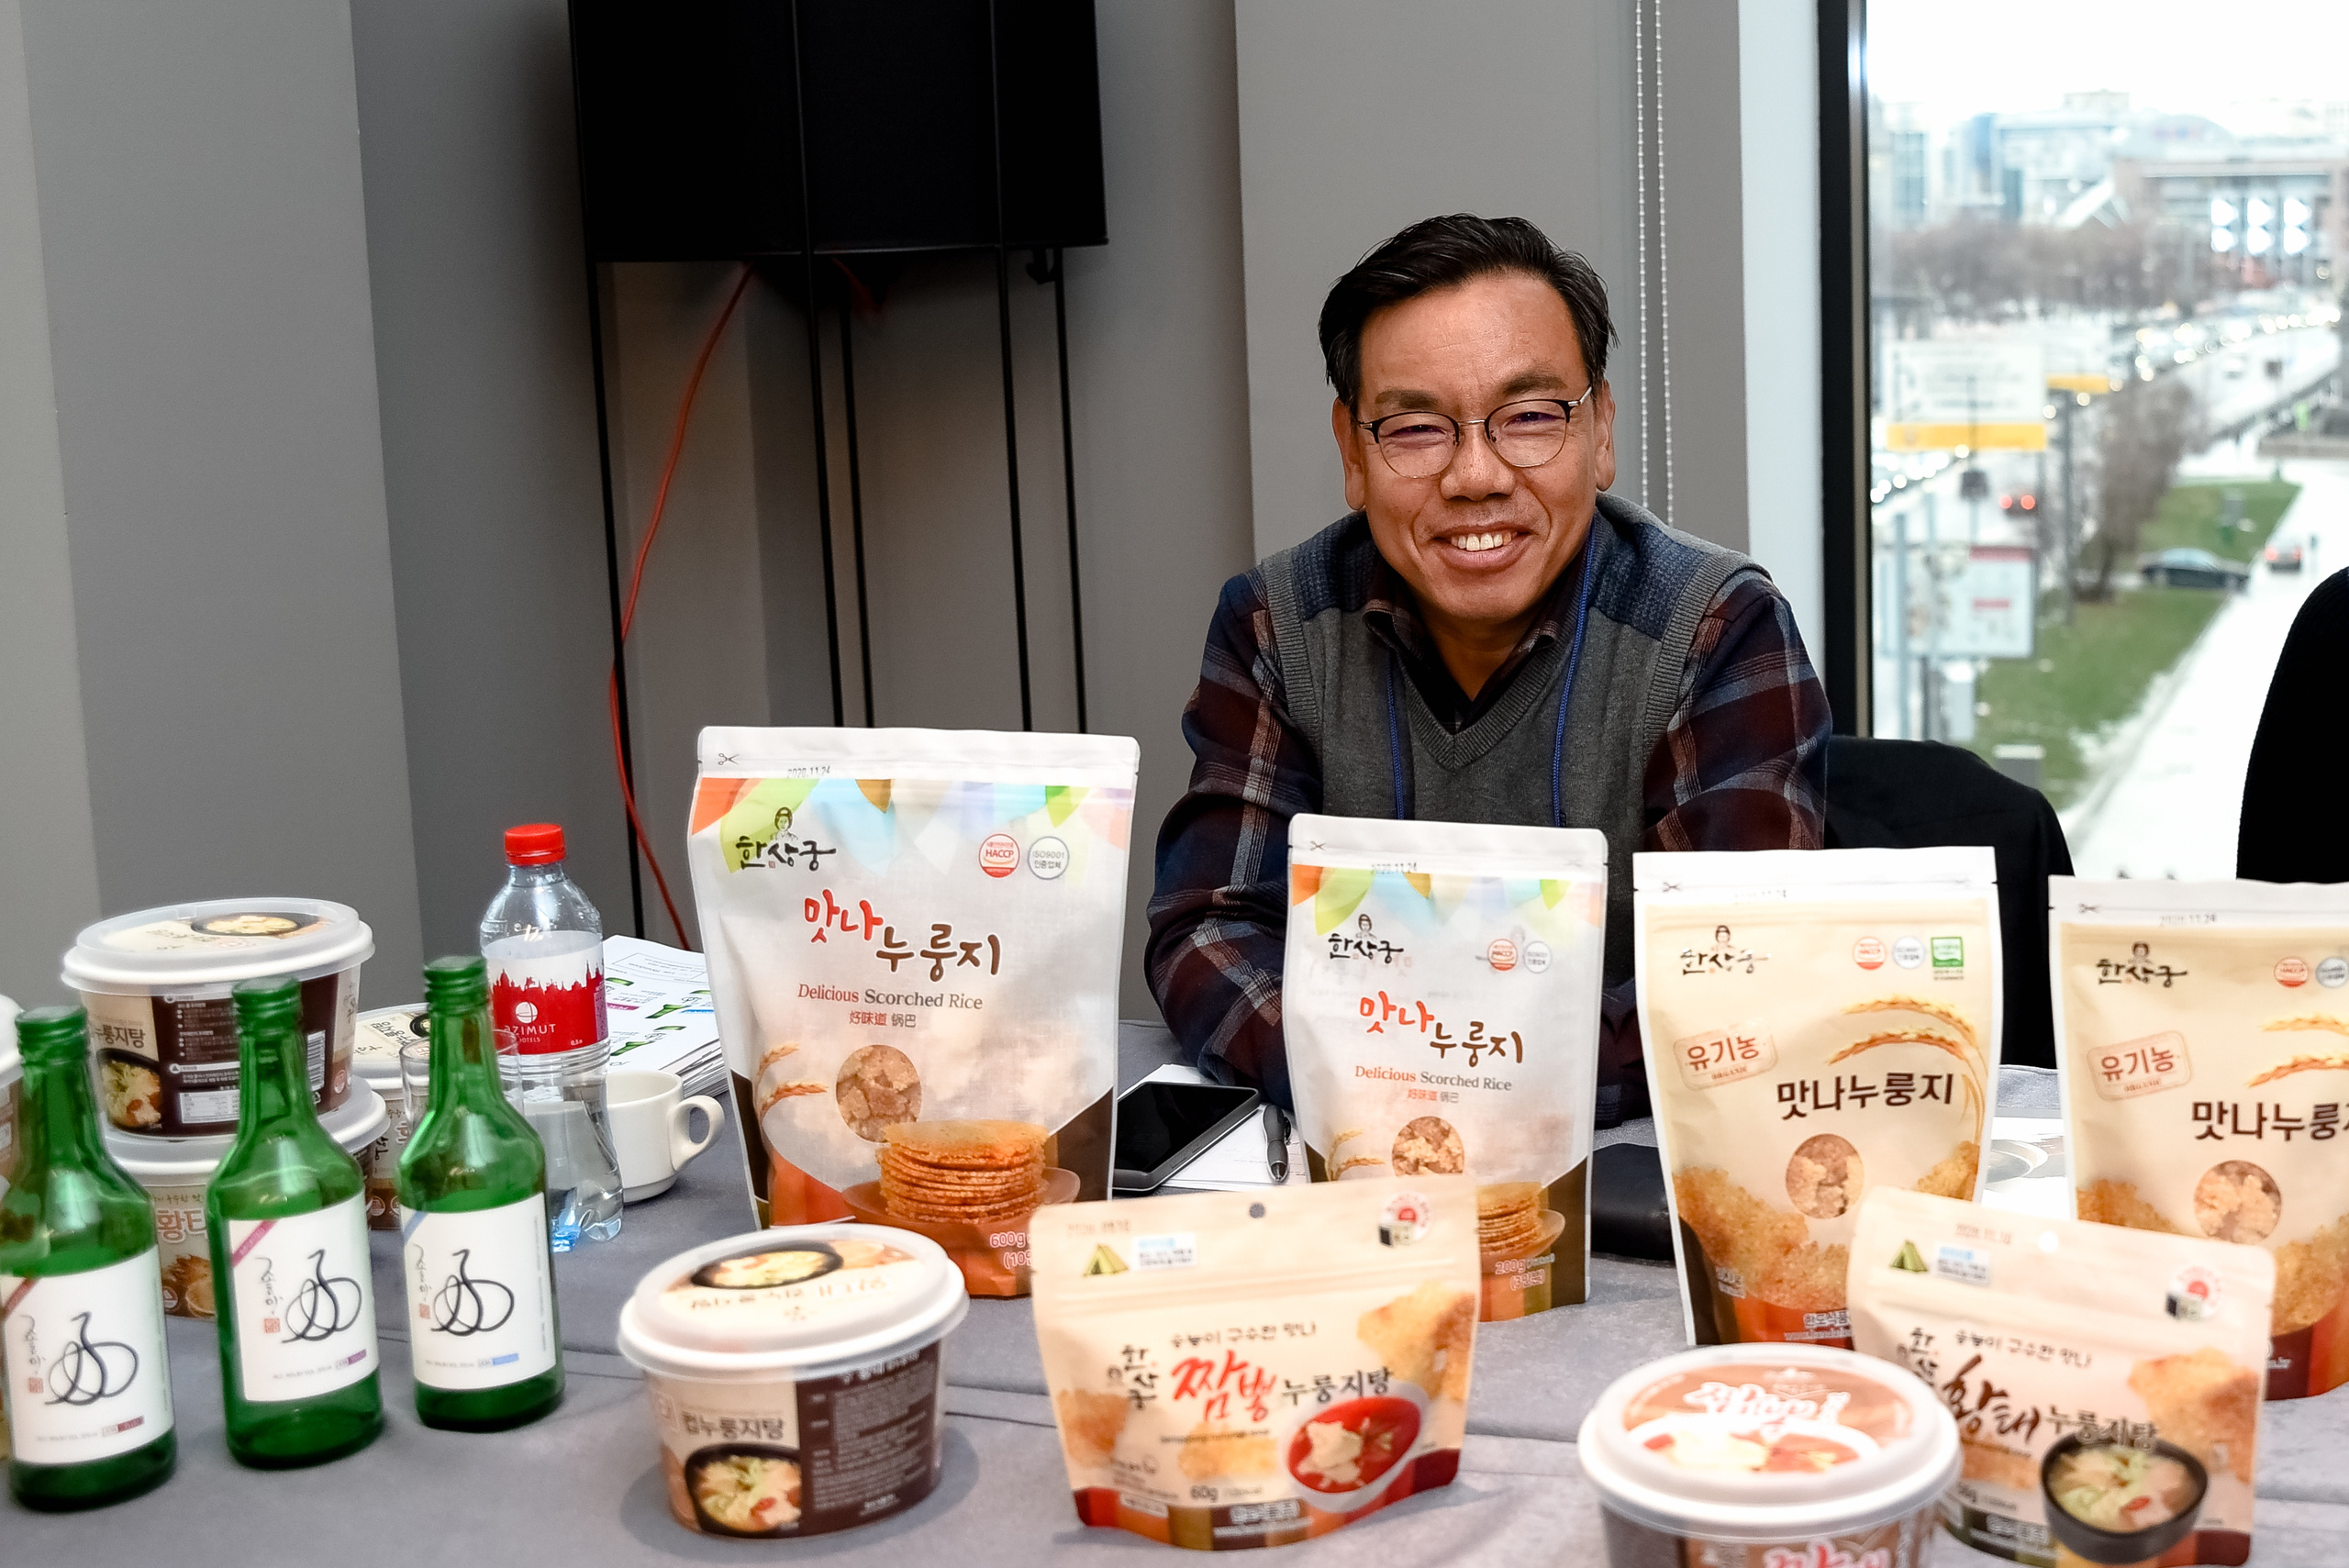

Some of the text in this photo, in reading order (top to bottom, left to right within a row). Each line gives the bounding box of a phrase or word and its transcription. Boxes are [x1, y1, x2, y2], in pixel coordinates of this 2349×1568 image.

[735, 835, 837, 872] 한상궁
[985, 850, 1014, 859] HACCP
[1032, 851, 1065, 860] ISO9001
[1328, 933, 1404, 964] 한상궁
[2096, 958, 2188, 988] 한상궁
[797, 984, 984, 1009] Delicious Scorched Rice
[1687, 1036, 1760, 1071] 유기농
[2101, 1047, 2174, 1082] 유기농
[1355, 1065, 1512, 1091] Delicious Scorched Rice
[1777, 1073, 1954, 1120] 맛나누룽지
[990, 1231, 1026, 1248] 600g
[1495, 1258, 1527, 1275] 200g
[1283, 1364, 1394, 1406] 누룽지탕
